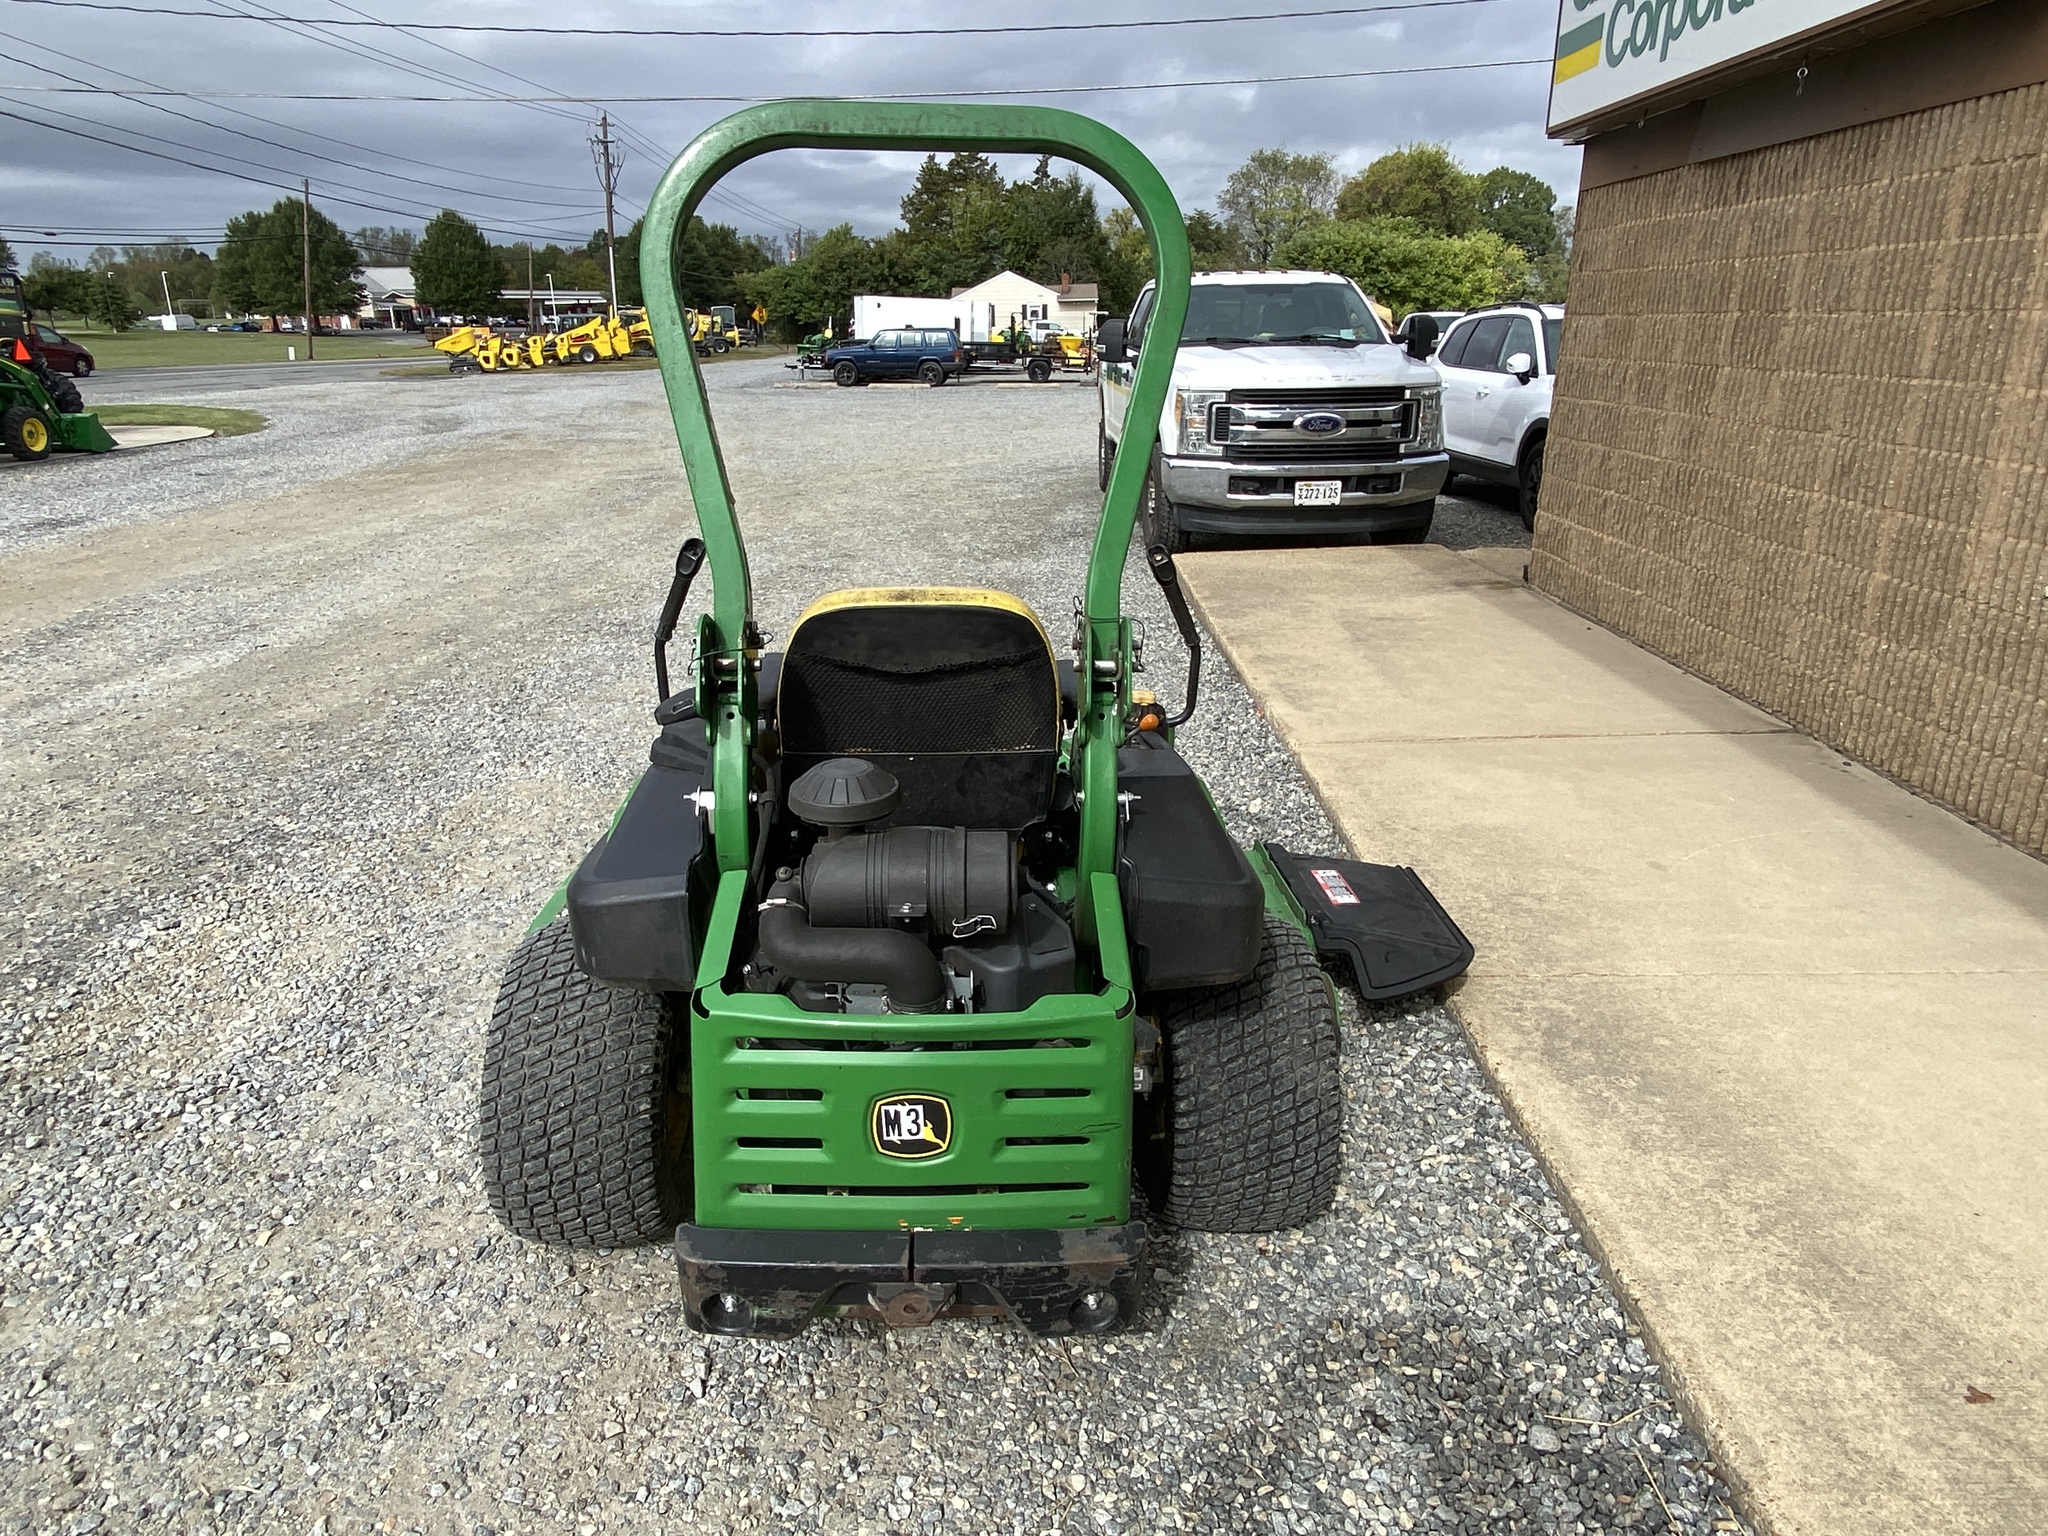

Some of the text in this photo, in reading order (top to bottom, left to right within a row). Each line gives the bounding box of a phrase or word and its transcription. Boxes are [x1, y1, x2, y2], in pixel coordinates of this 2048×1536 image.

[1605, 0, 1754, 68] Corpo
[1308, 419, 1333, 430] Ford
[1304, 487, 1339, 500] 272-125
